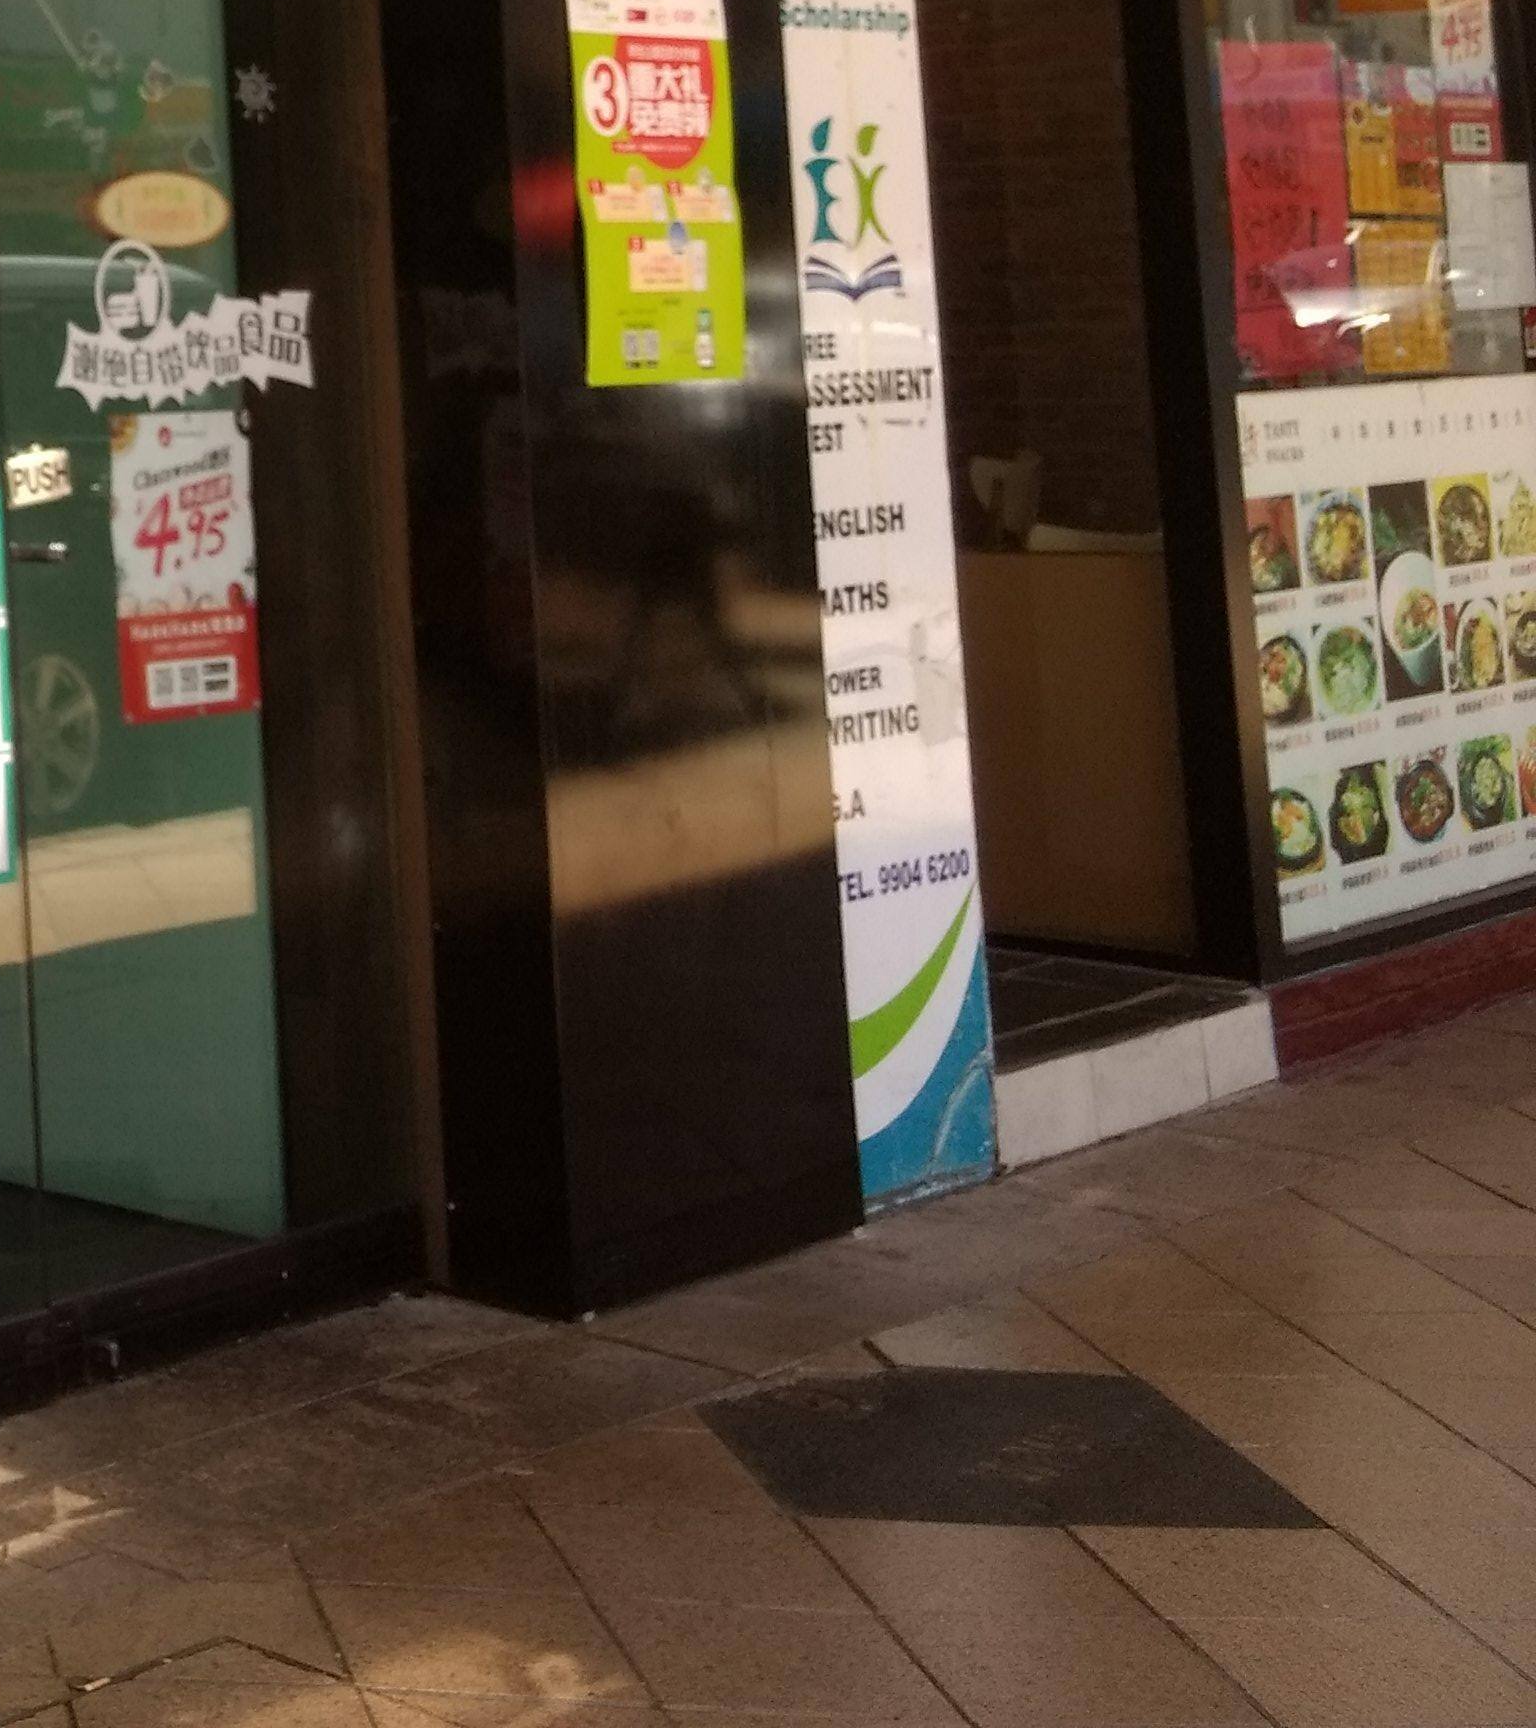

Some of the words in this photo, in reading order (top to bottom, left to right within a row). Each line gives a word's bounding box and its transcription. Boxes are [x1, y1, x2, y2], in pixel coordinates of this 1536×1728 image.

[593, 63, 617, 128] 3
[808, 368, 932, 407] SSESSMENT
[10, 463, 69, 497] PUSH
